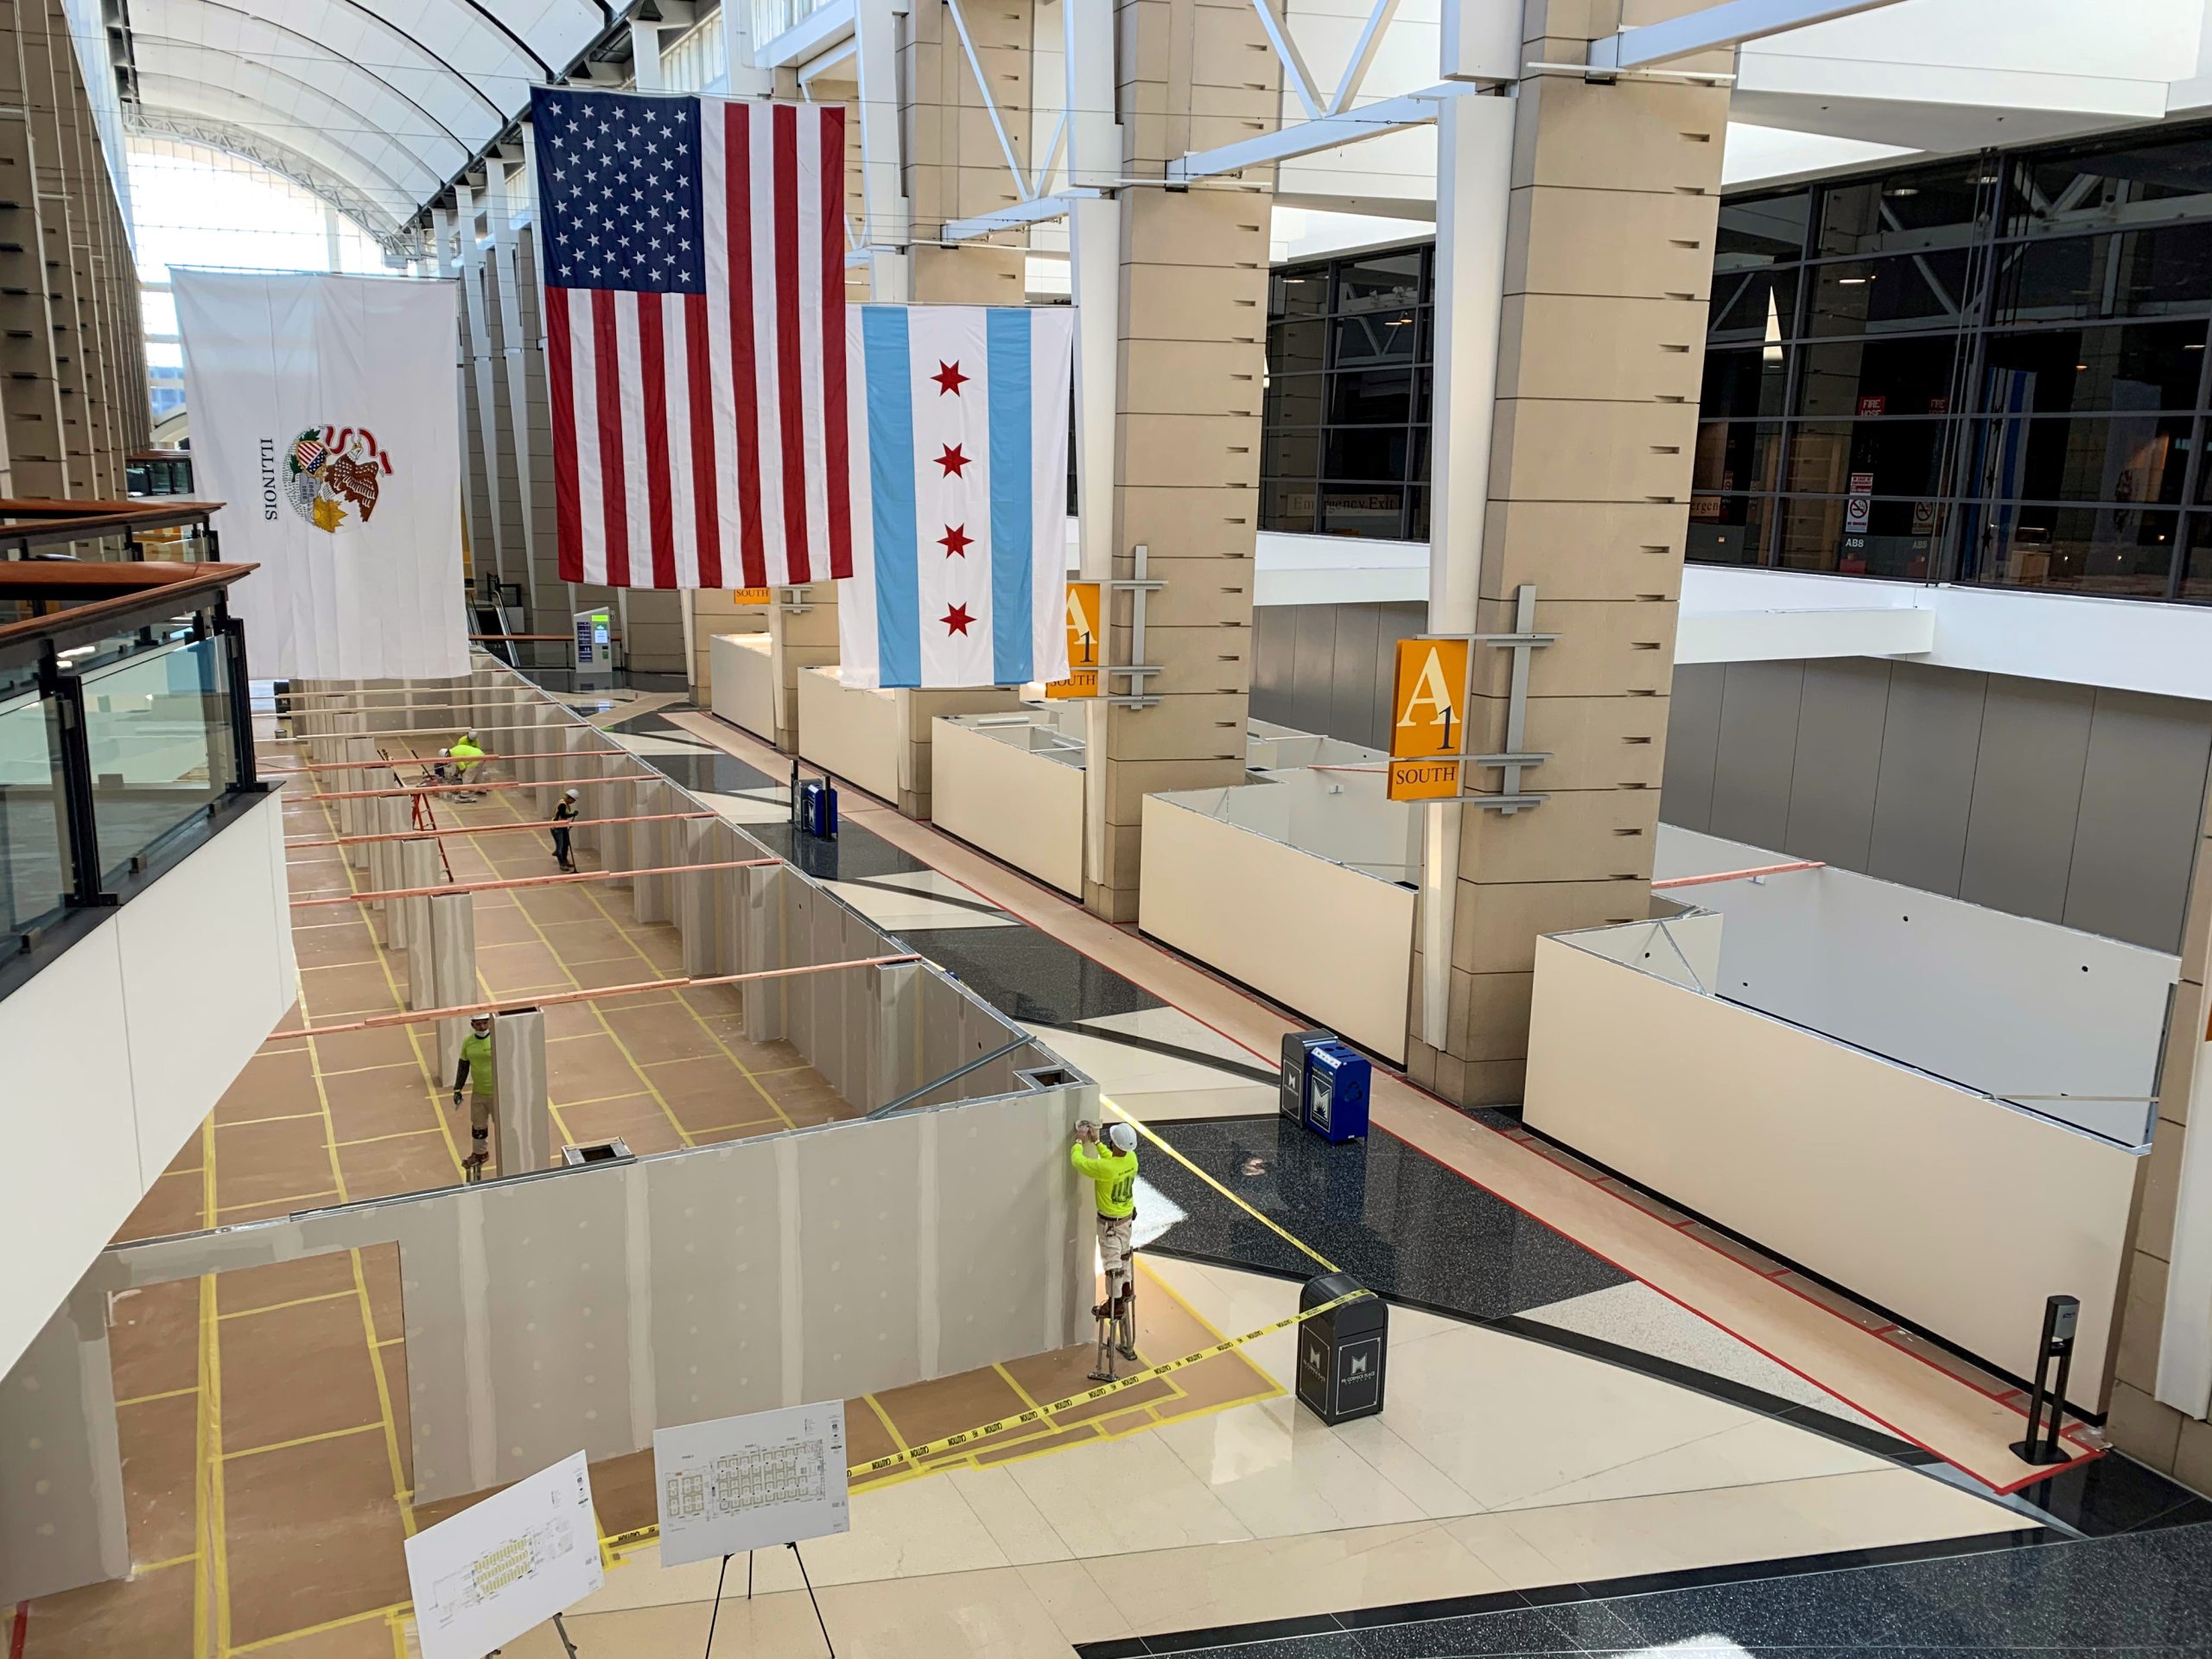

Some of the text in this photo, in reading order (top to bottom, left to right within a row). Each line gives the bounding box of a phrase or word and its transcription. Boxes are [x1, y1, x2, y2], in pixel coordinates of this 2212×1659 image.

[261, 438, 277, 520] ILLINOIS
[1294, 497, 1394, 514] Emrgency Exit
[1846, 538, 1864, 547] AB8
[1395, 766, 1456, 785] SOUTH
